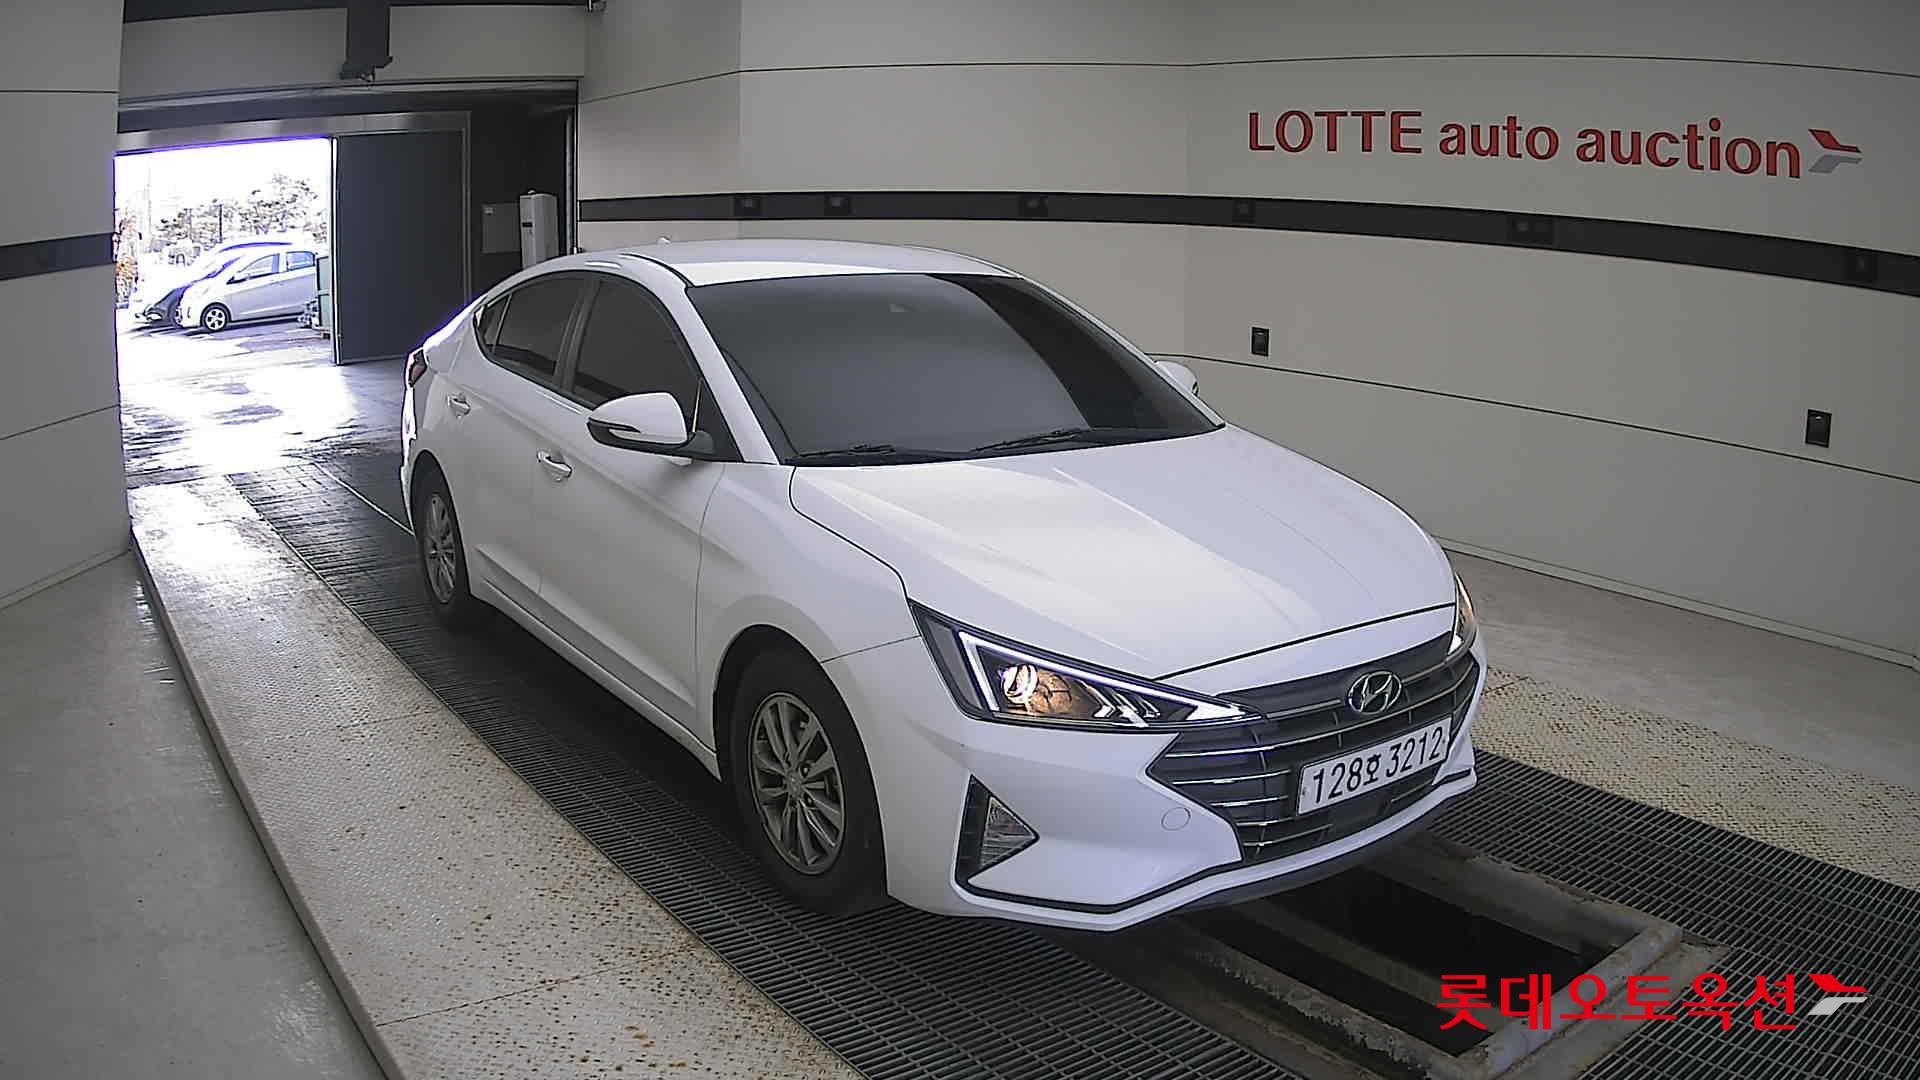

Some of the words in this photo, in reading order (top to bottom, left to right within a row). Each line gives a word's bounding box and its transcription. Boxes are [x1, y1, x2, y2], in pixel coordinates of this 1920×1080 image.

[1249, 110, 1422, 154] LOTTE
[1439, 115, 1560, 160] auto
[1576, 117, 1801, 179] auction
